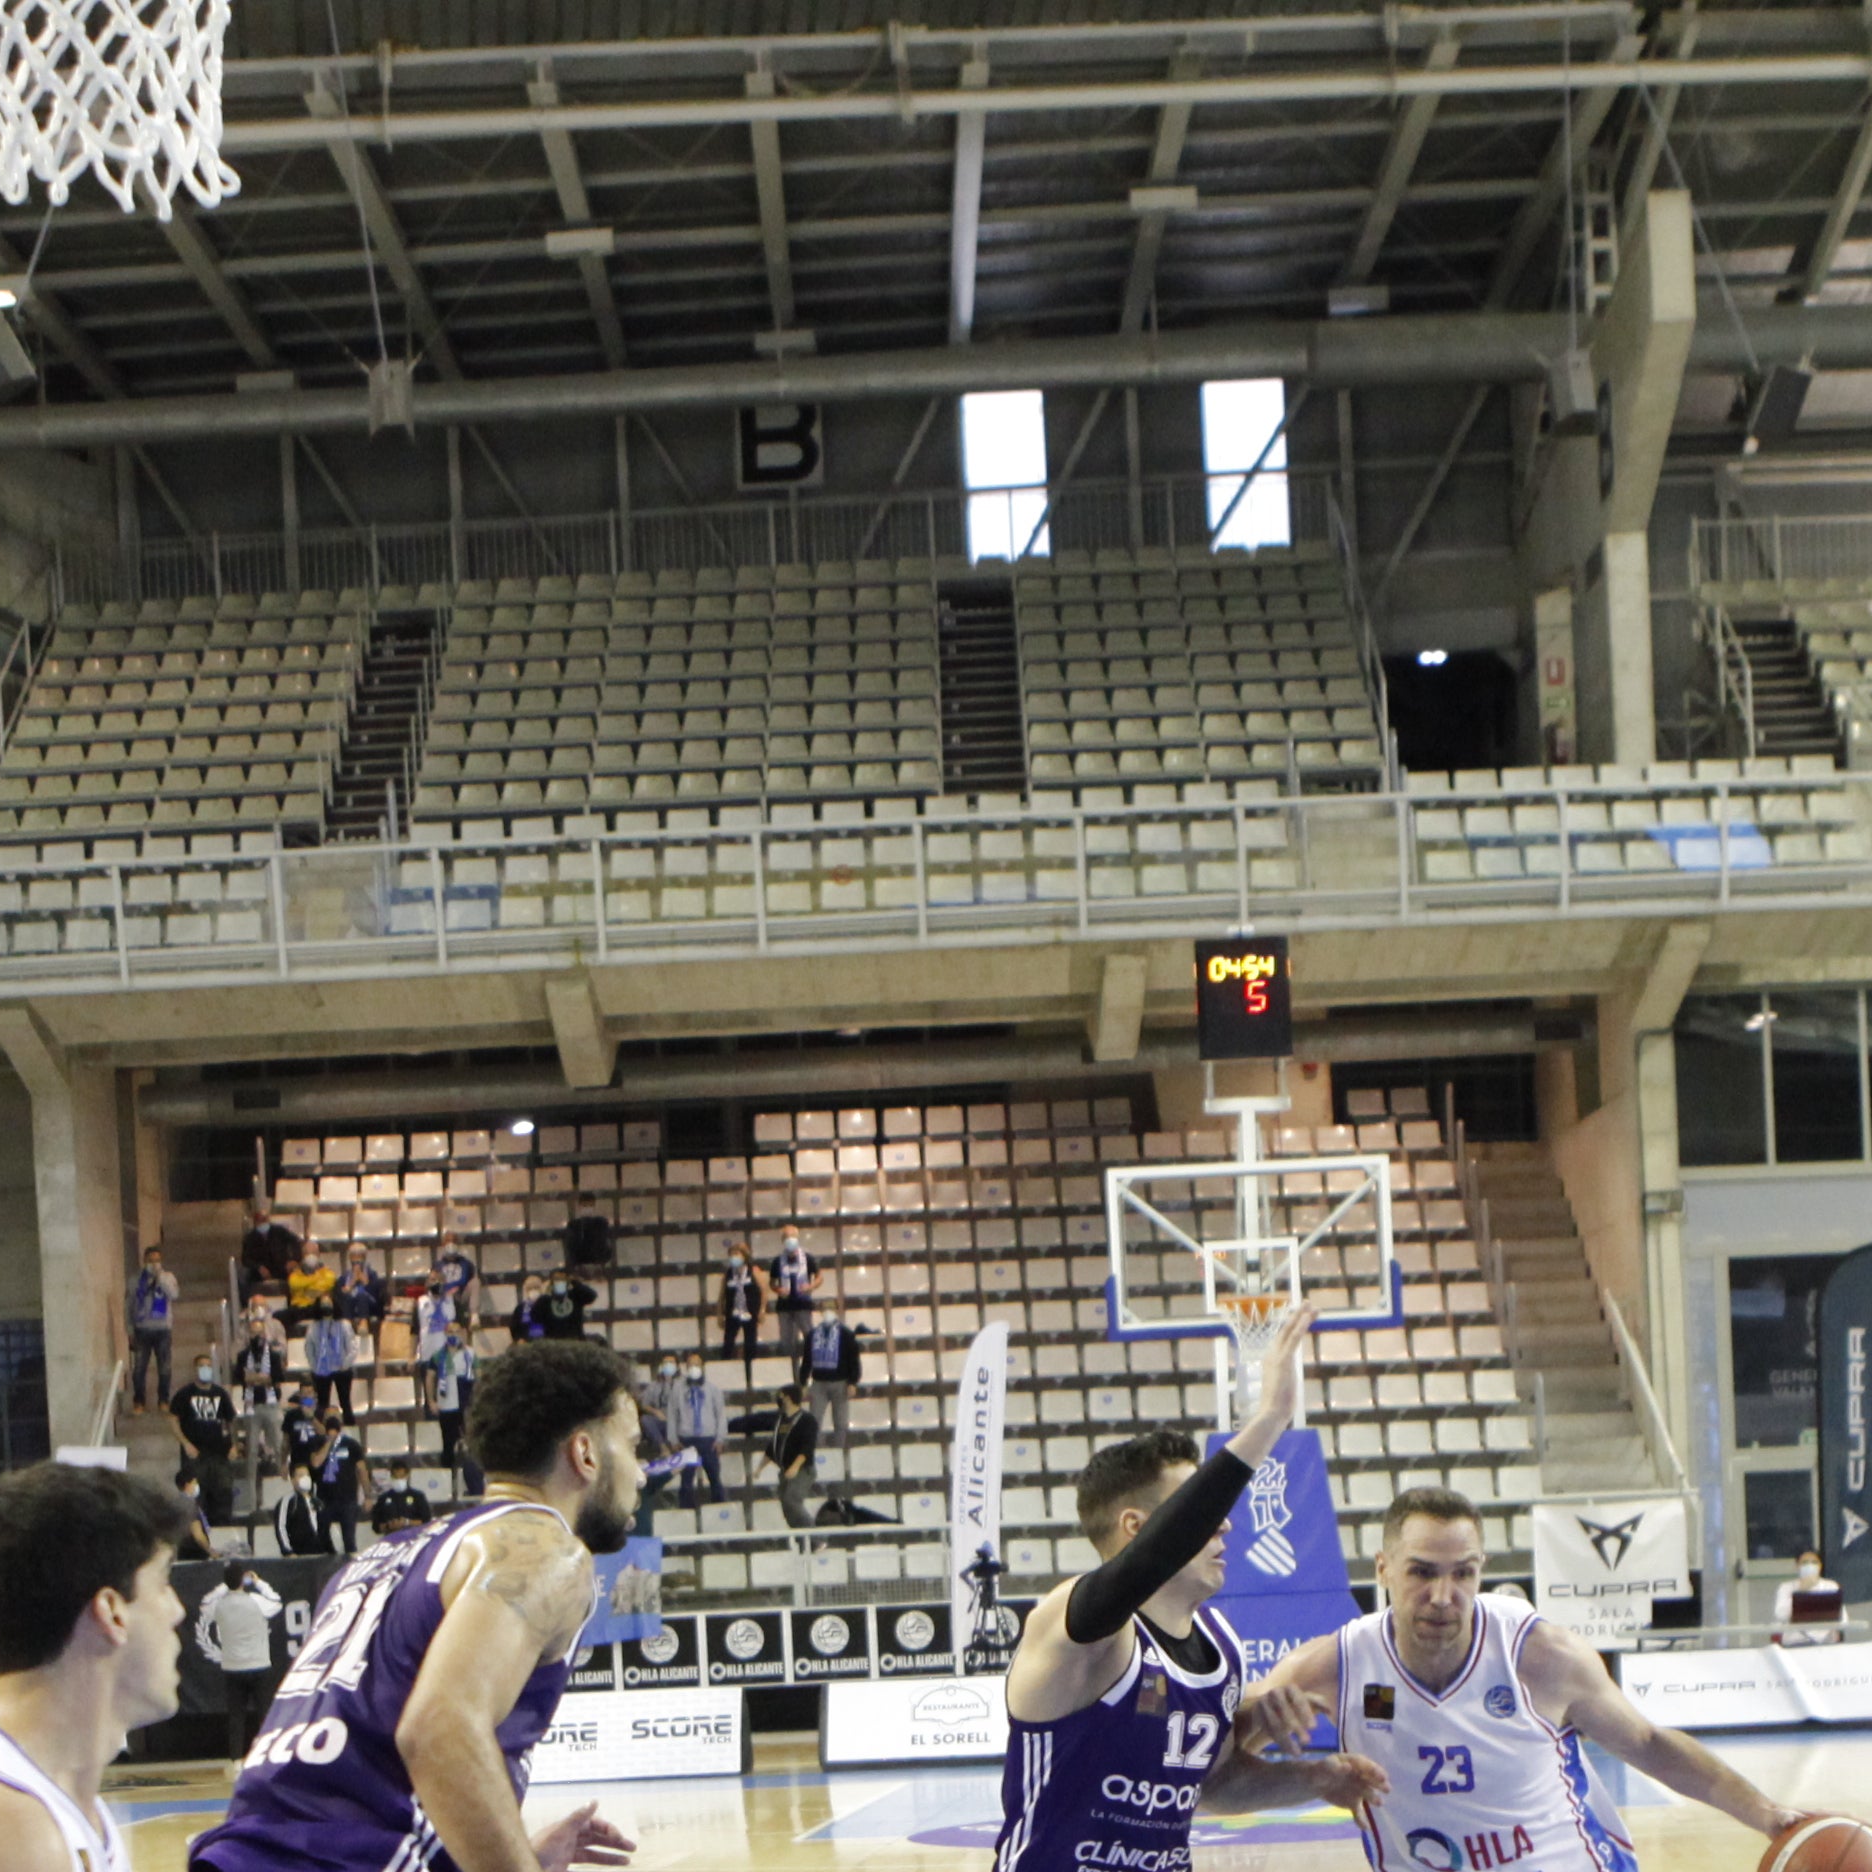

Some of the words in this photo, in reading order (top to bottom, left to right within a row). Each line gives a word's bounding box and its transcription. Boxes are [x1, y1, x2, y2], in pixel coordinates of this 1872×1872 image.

[1246, 979, 1269, 1014] 5
[1846, 1326, 1867, 1493] CUPRA
[967, 1365, 991, 1528] Alicante
[1548, 1578, 1678, 1598] CUPRA
[274, 1569, 404, 1699] 21
[725, 1664, 744, 1677] HLA
[744, 1661, 784, 1676] ALICANTE
[810, 1659, 830, 1673] HLA
[830, 1656, 870, 1672] ALICANTE
[895, 1654, 915, 1669] HLA
[915, 1652, 956, 1668] ALICANTE
[575, 1670, 613, 1685] ALICANTE
[640, 1669, 658, 1682] HLA
[659, 1666, 699, 1681] ALICANTE
[1663, 1680, 1756, 1693] CUPRA
[922, 1702, 981, 1712] RESTAURANTE
[631, 1714, 733, 1740] SCORE
[702, 1736, 733, 1745] TECH
[911, 1733, 927, 1746] EL
[932, 1731, 991, 1746] SORELL
[1162, 1710, 1220, 1769] 12
[568, 1744, 598, 1752] TECH
[1417, 1744, 1476, 1796] 23
[1464, 1823, 1535, 1872] HLA
